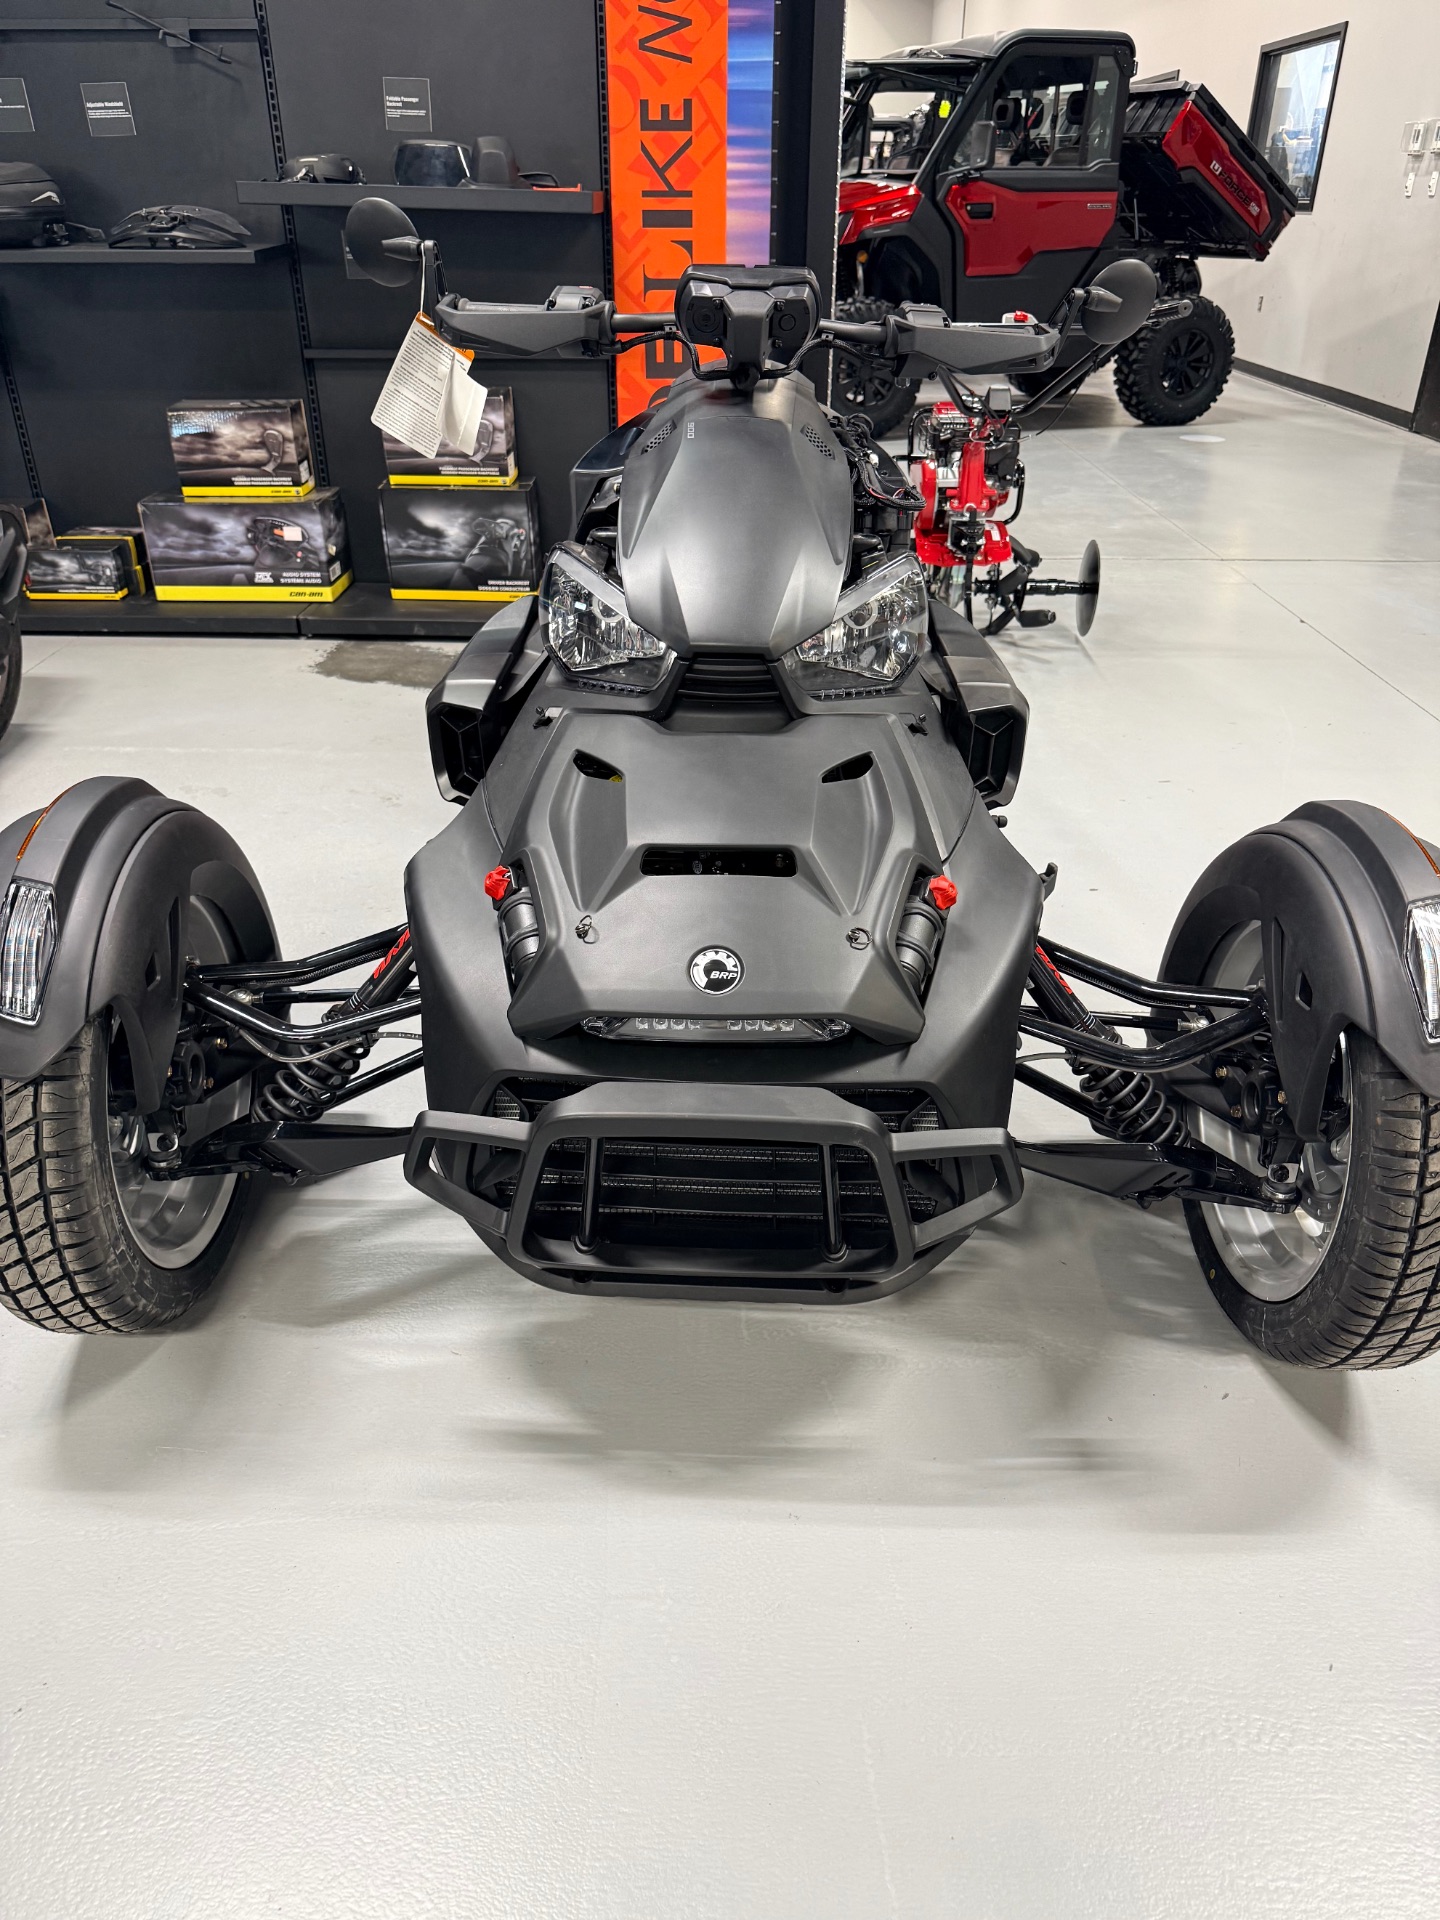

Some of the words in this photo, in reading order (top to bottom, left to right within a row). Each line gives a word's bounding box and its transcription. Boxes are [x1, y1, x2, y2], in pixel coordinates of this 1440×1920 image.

[638, 0, 692, 64] N
[640, 98, 692, 302] LIKE
[710, 970, 738, 980] BRP
